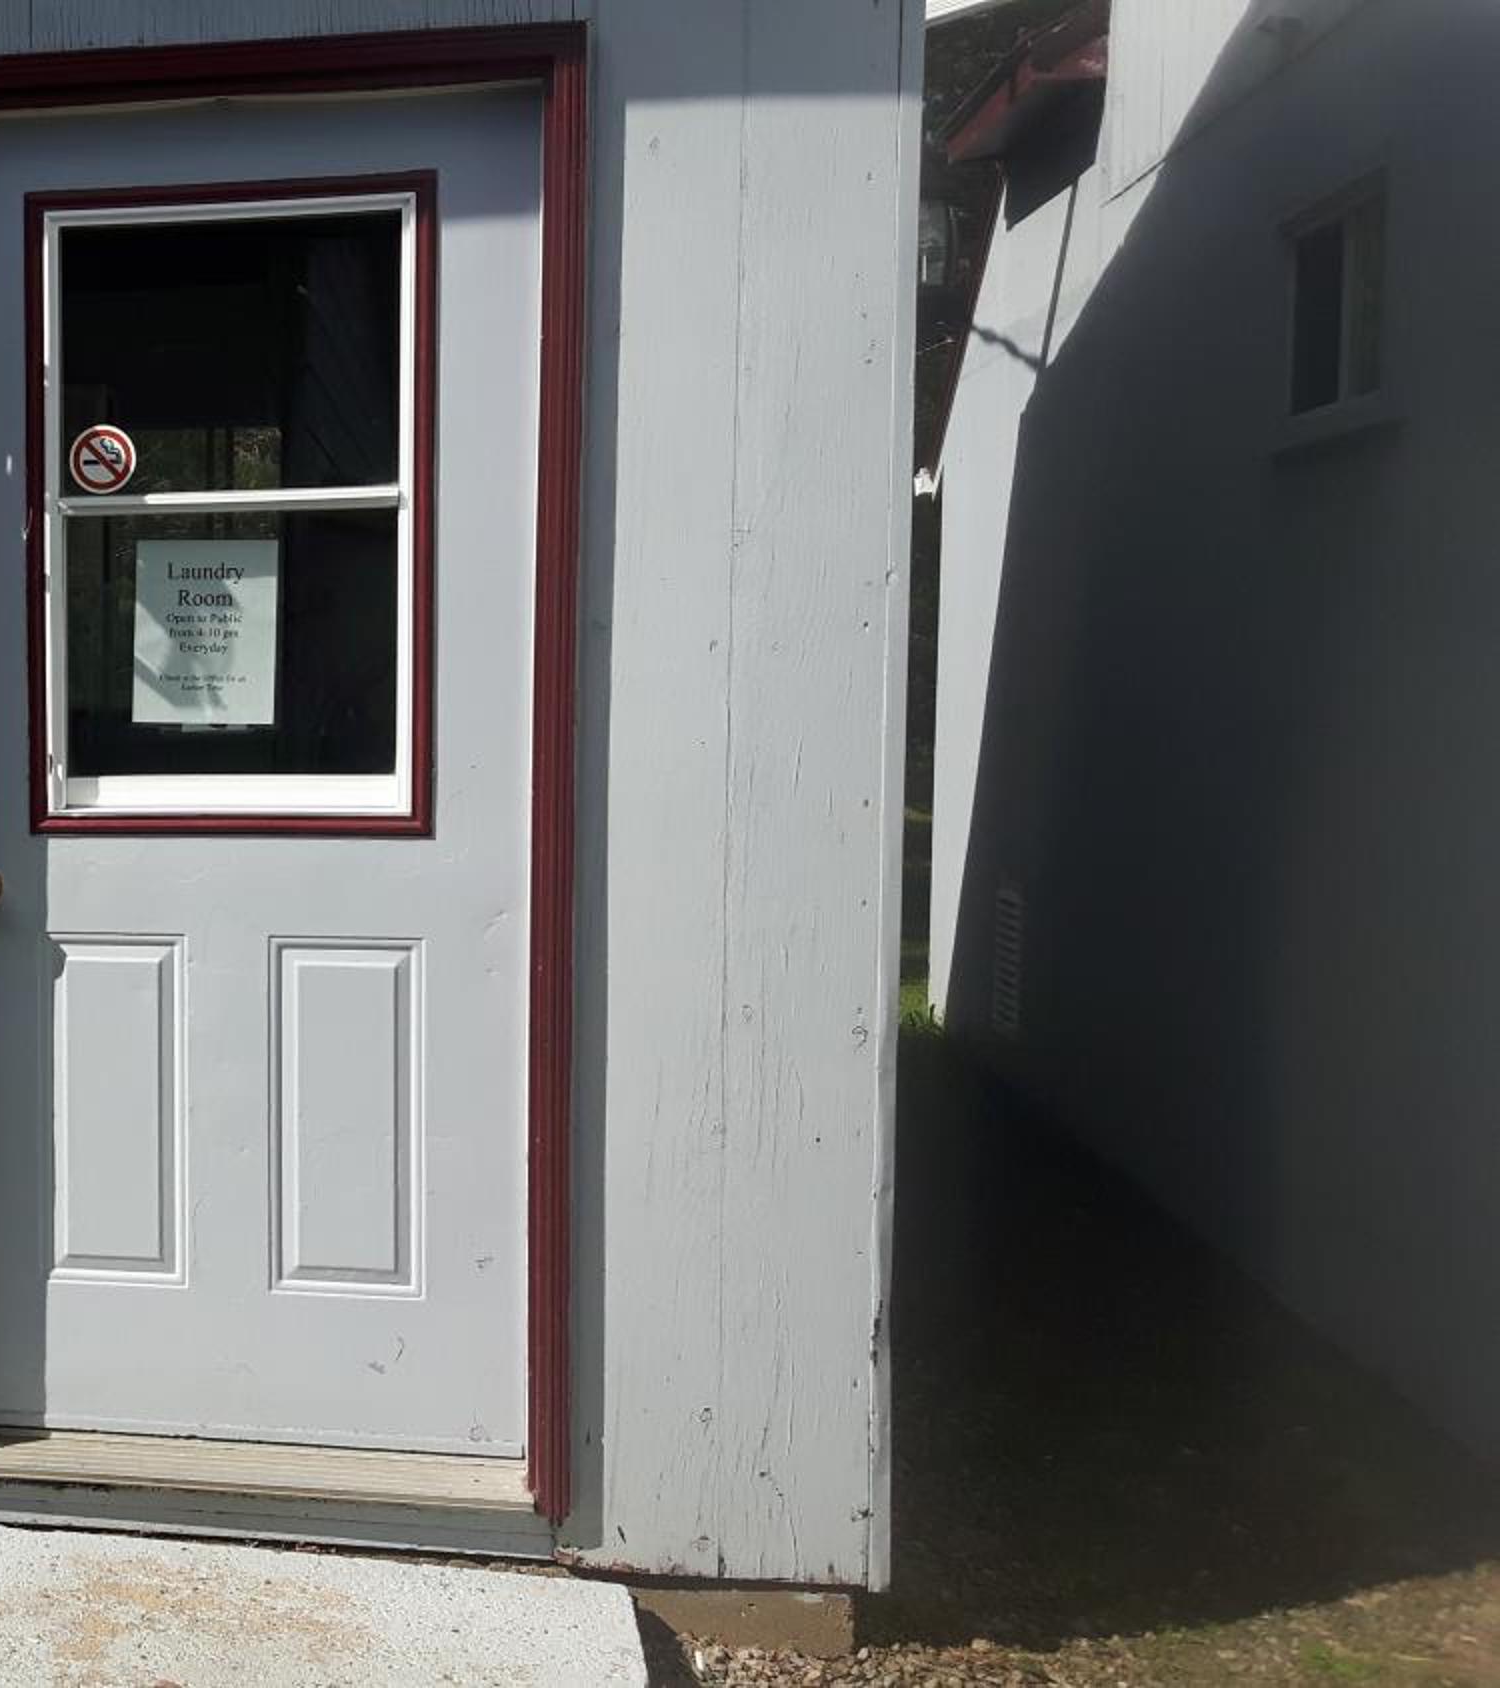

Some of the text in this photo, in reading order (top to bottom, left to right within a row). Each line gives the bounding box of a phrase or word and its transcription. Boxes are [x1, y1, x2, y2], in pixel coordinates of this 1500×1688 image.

[167, 561, 245, 584] Laundry
[178, 589, 233, 606] Room
[166, 613, 195, 624] Open
[209, 613, 244, 623] Public
[169, 627, 194, 637] from
[179, 642, 228, 654] Everyday
